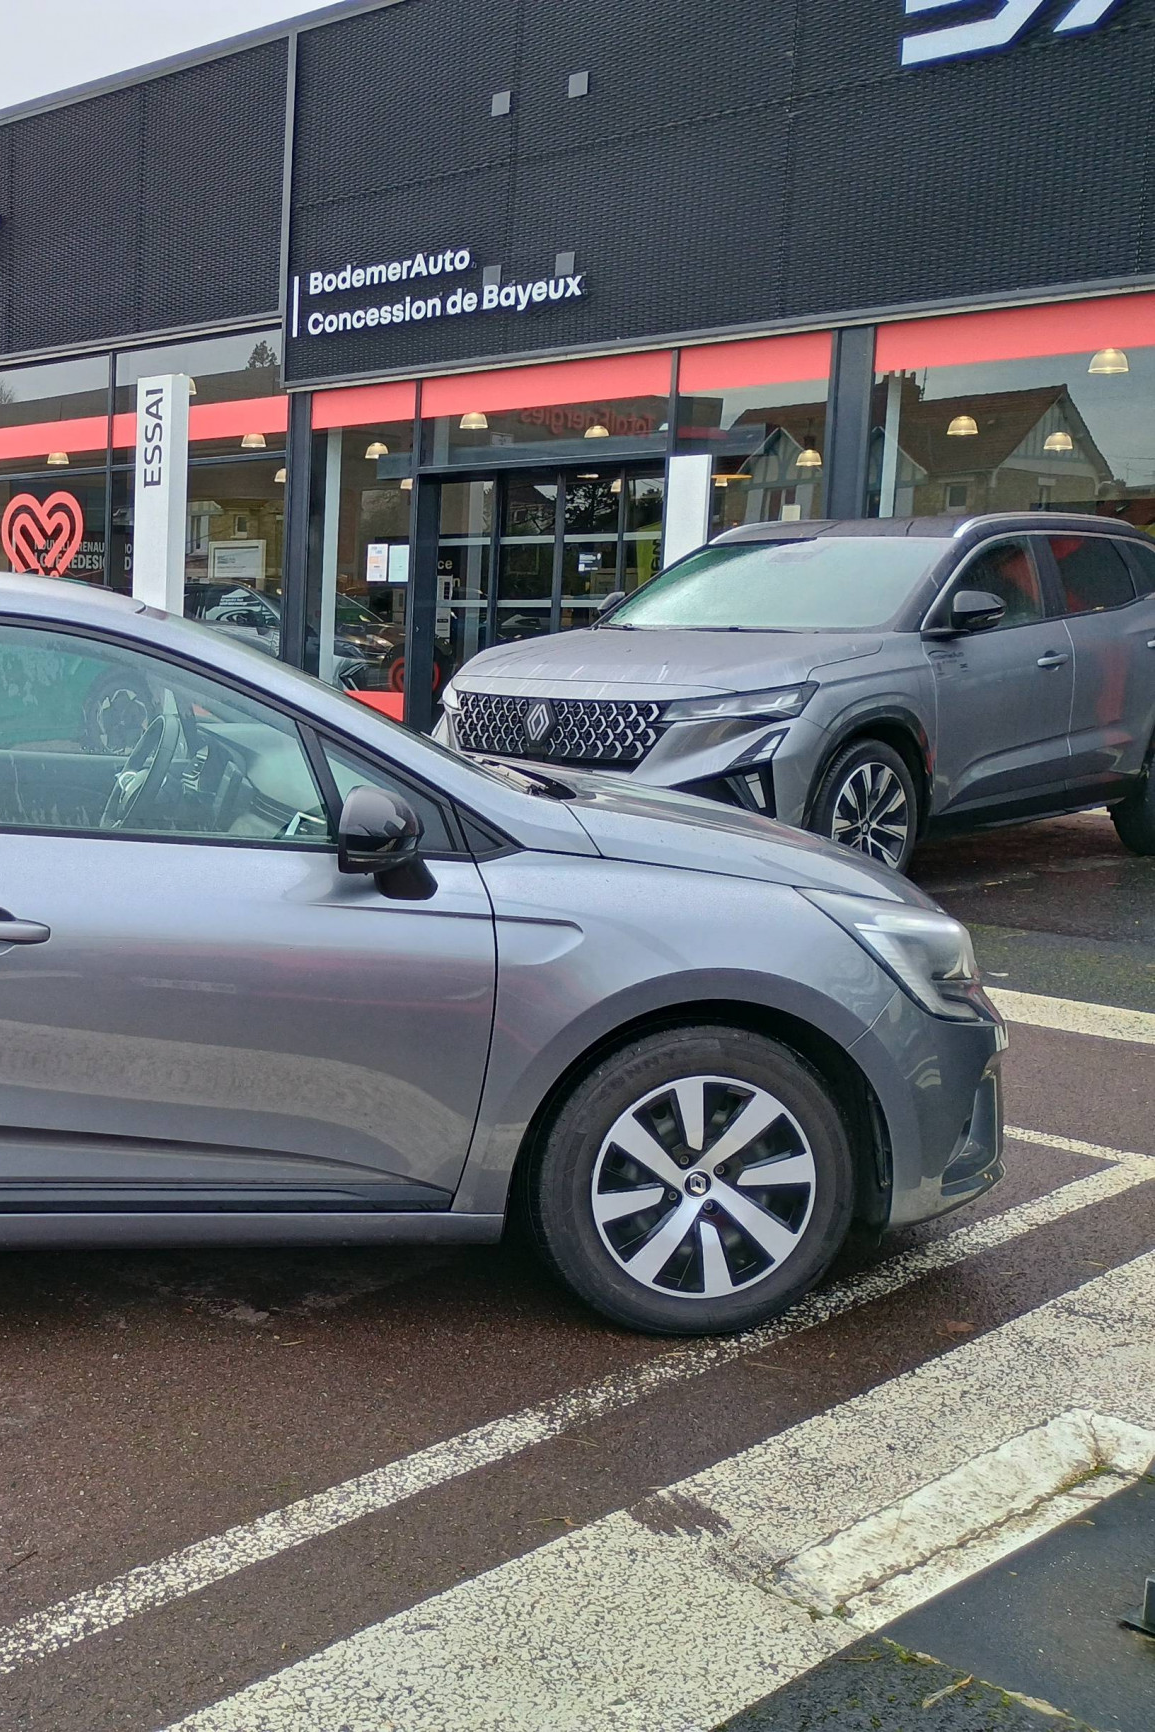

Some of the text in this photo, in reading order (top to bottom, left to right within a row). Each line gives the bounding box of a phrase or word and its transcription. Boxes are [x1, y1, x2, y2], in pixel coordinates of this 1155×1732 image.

[308, 249, 471, 296] BodemerAuto
[307, 274, 583, 336] Concession de Bayeux
[143, 387, 165, 489] ESSAI
